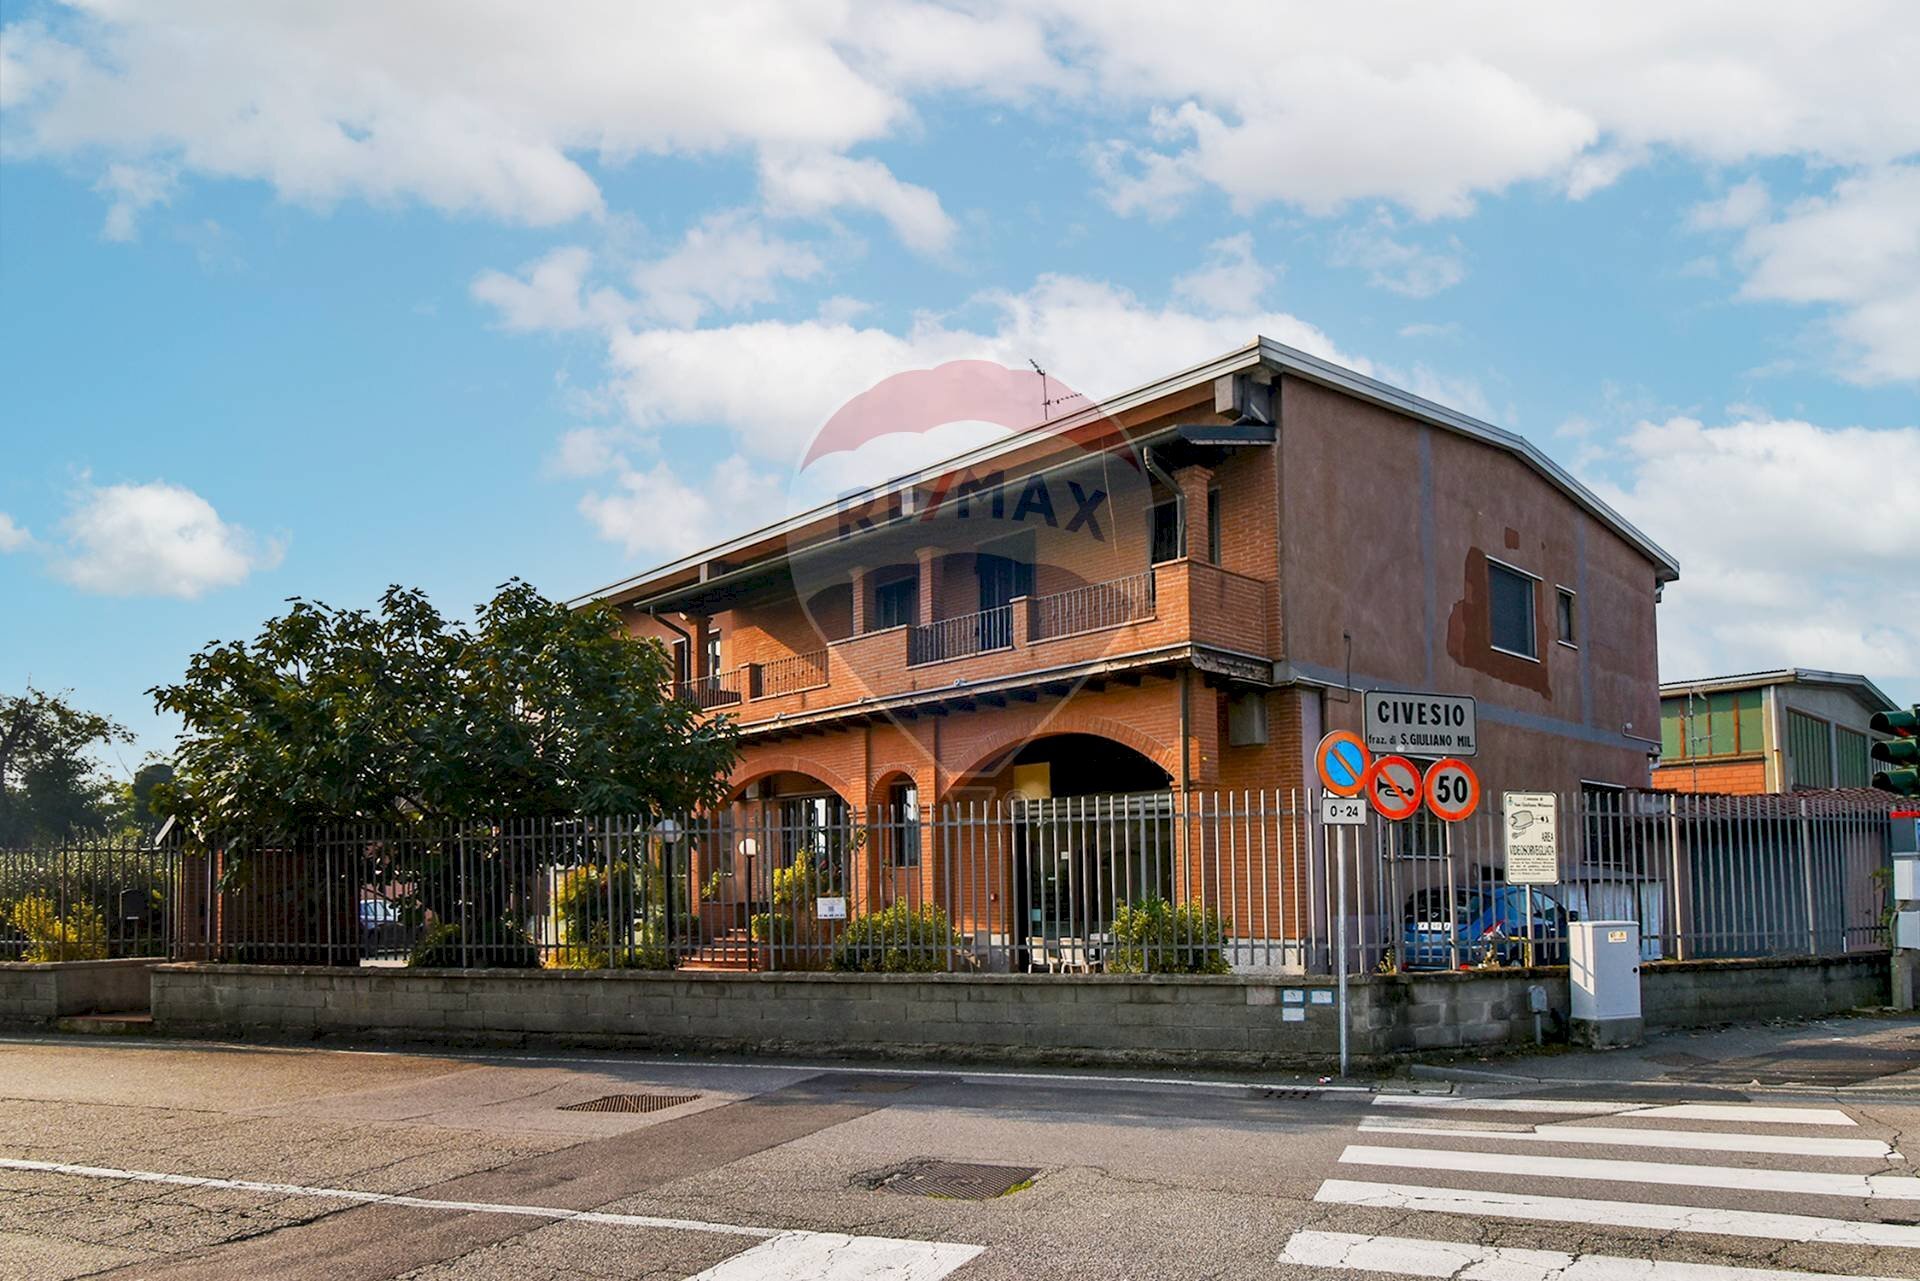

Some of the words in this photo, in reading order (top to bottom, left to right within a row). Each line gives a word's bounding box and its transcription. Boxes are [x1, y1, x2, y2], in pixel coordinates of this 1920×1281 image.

[1377, 700, 1466, 727] CIVESIO
[1368, 734, 1387, 745] fraz.
[1389, 735, 1397, 745] di
[1457, 735, 1475, 748] MIL.
[1436, 775, 1468, 804] 50
